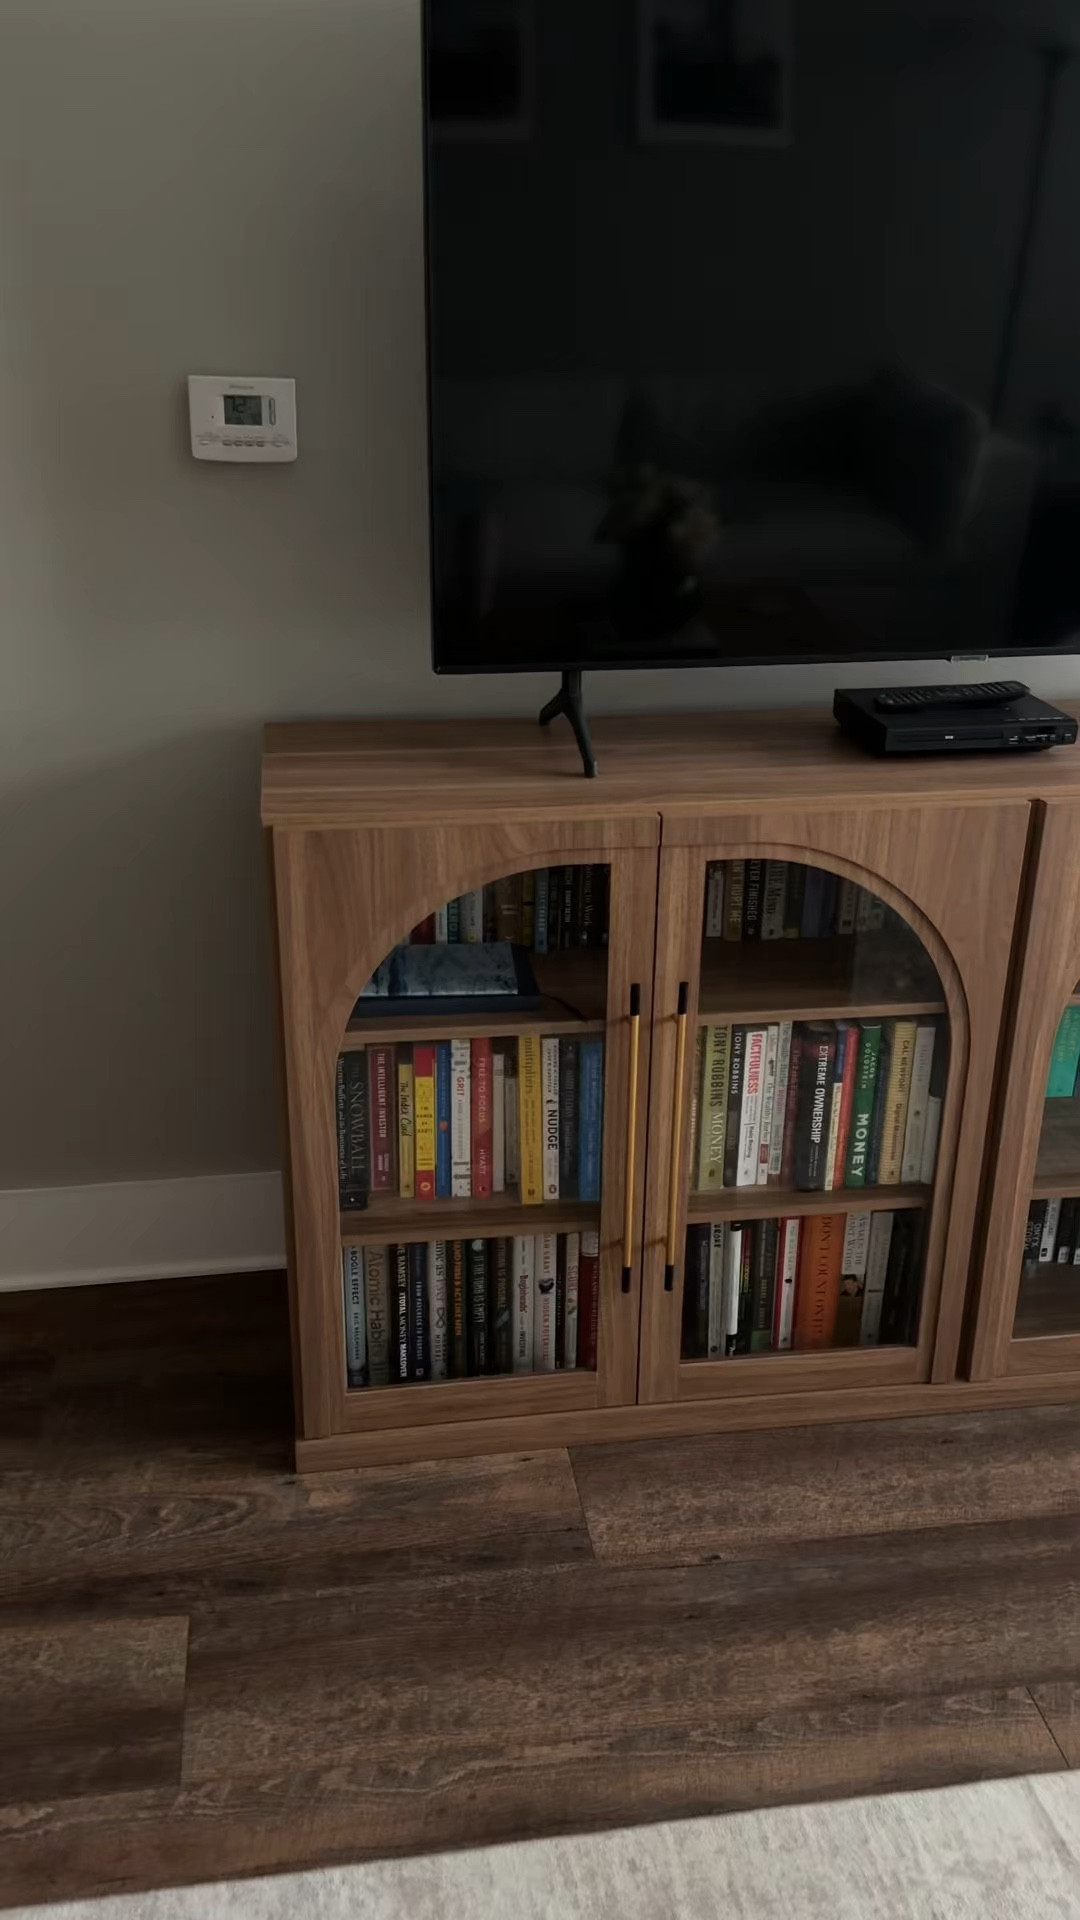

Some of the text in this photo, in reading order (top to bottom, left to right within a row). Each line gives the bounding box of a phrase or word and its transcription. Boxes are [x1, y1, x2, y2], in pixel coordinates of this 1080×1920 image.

[583, 905, 593, 927] Work
[729, 911, 740, 923] ME
[747, 882, 759, 921] FINISHED
[709, 1026, 728, 1107] TONY ROBBINS
[731, 1032, 741, 1094] TONY ROBBINS
[747, 1033, 763, 1094] FACTFULNESS
[817, 1045, 828, 1086] EXTREME
[861, 1042, 871, 1089] GOLDSTEIN
[897, 1056, 908, 1093] NEWPORT
[377, 1053, 387, 1137] THE INTELLIGENT INVESTOR
[479, 1082, 485, 1092] TO
[349, 1081, 365, 1174] SNOWBALL
[400, 1081, 412, 1136] The Index Card
[810, 1088, 825, 1144] OWNERSHIP
[547, 1109, 557, 1150] NUDGE
[710, 1112, 724, 1164] MONEY
[851, 1114, 869, 1177] MONEY
[435, 1241, 445, 1262] ame
[1031, 1223, 1041, 1248] ONYX
[351, 1250, 359, 1276] BOGLE
[368, 1251, 384, 1306] Atomic
[436, 1265, 444, 1276] as
[473, 1264, 485, 1276] THE
[473, 1276, 485, 1294] TOMB
[473, 1303, 485, 1323] EMPTY
[399, 1344, 407, 1377] MAKEOVER
